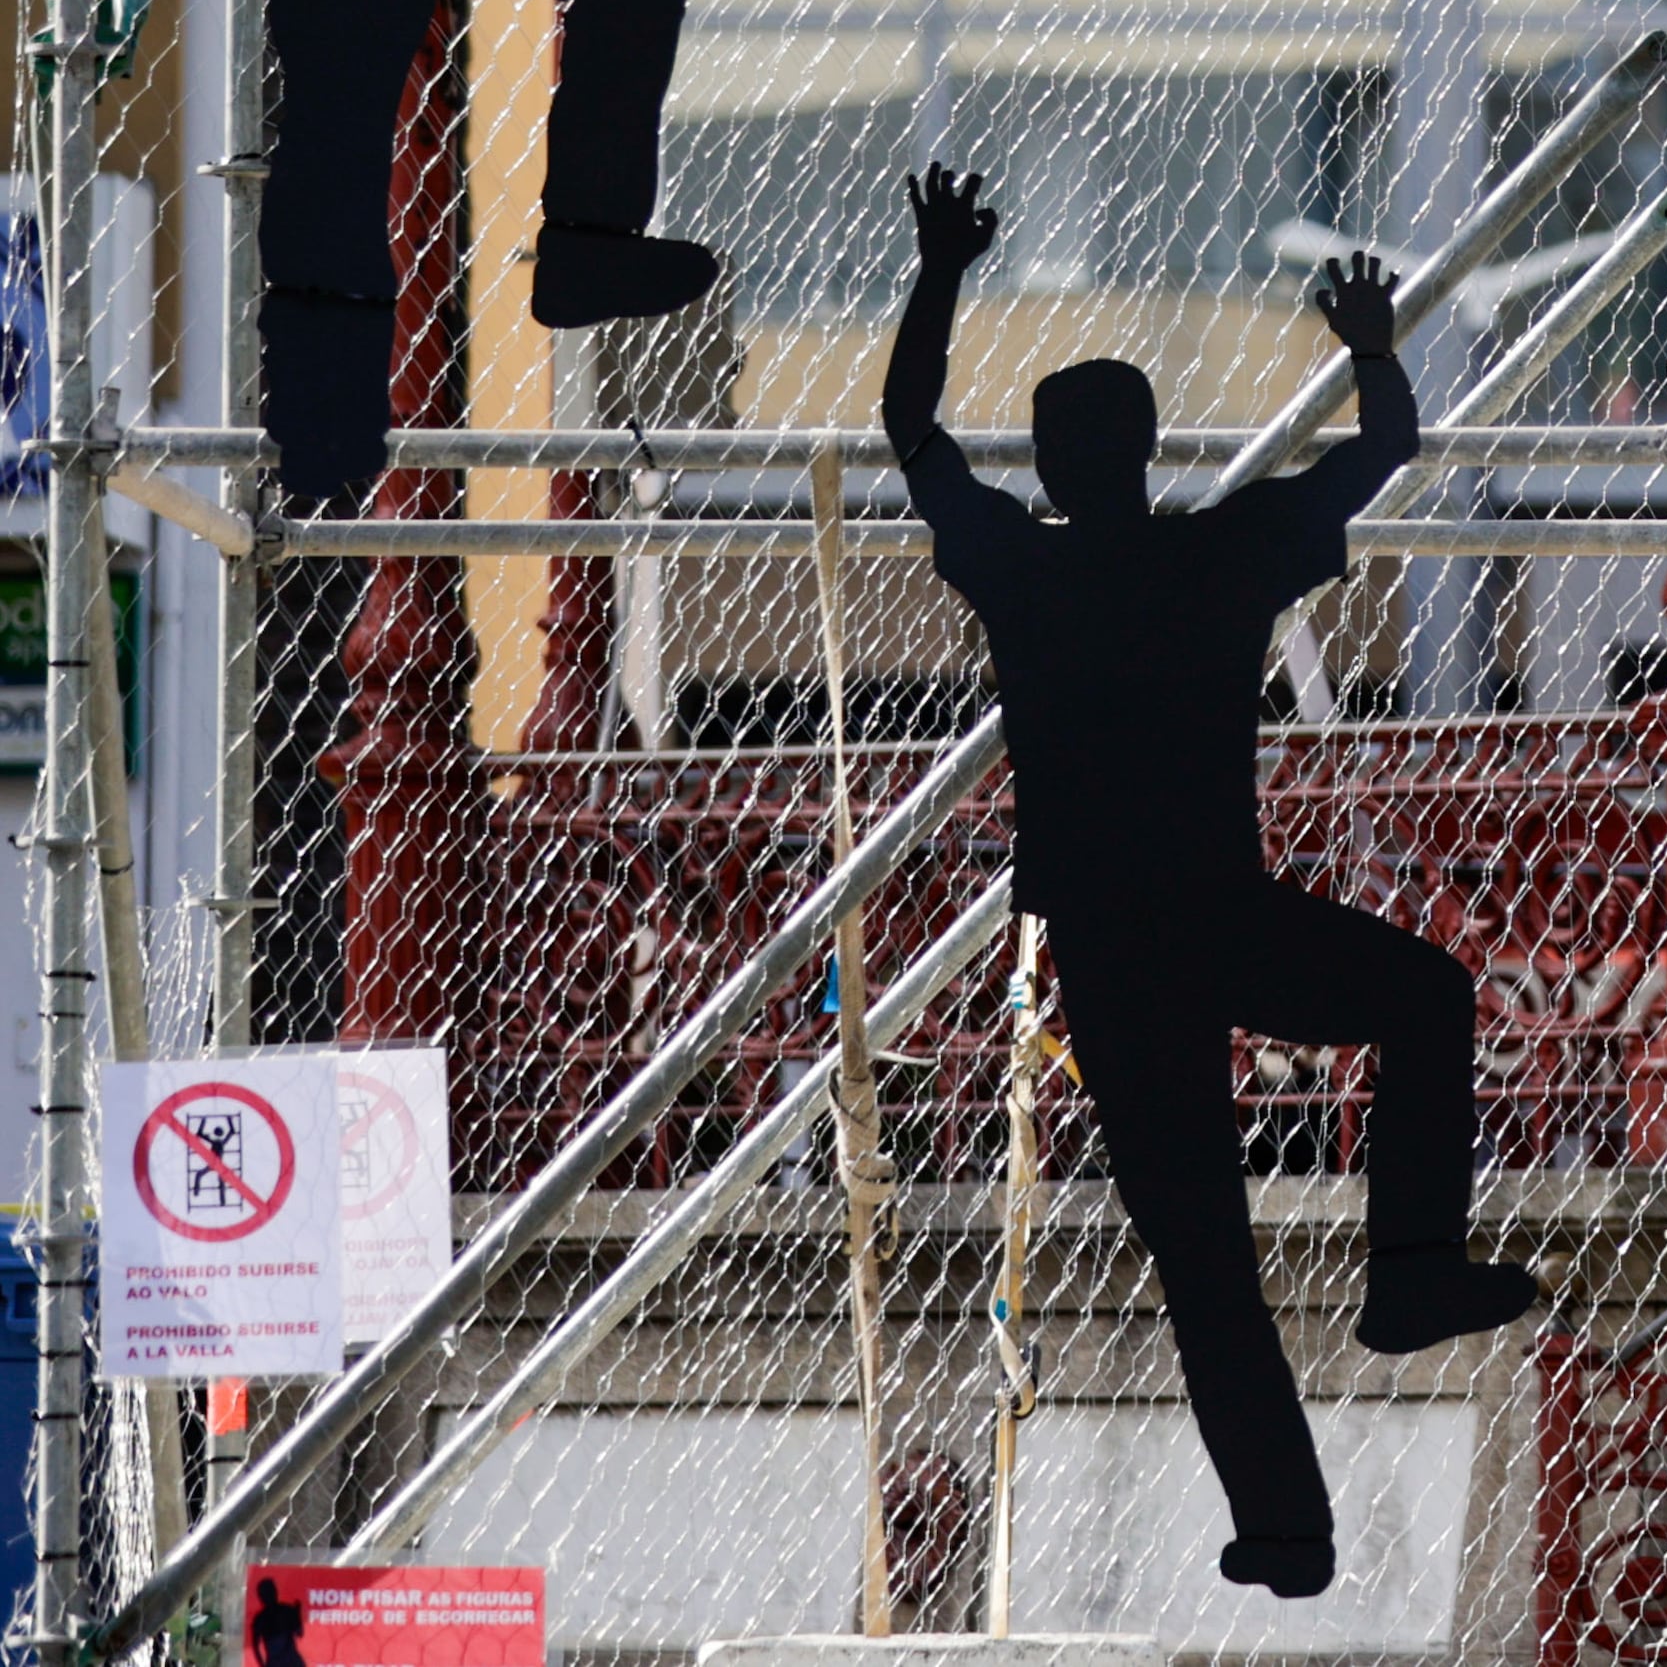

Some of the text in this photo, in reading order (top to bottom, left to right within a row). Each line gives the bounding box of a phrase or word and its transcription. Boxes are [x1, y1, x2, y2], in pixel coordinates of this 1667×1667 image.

[126, 1262, 320, 1280] PROHIBIDO SUBIRSE
[126, 1285, 208, 1300] AO VALO
[126, 1321, 320, 1339] PROHIBIDO SUBIRSE
[127, 1344, 234, 1359] A LA VALLA
[308, 1589, 534, 1606] NON PISAR AS FIGURAS
[308, 1609, 535, 1625] PERIGO DE ESCORREGAR
